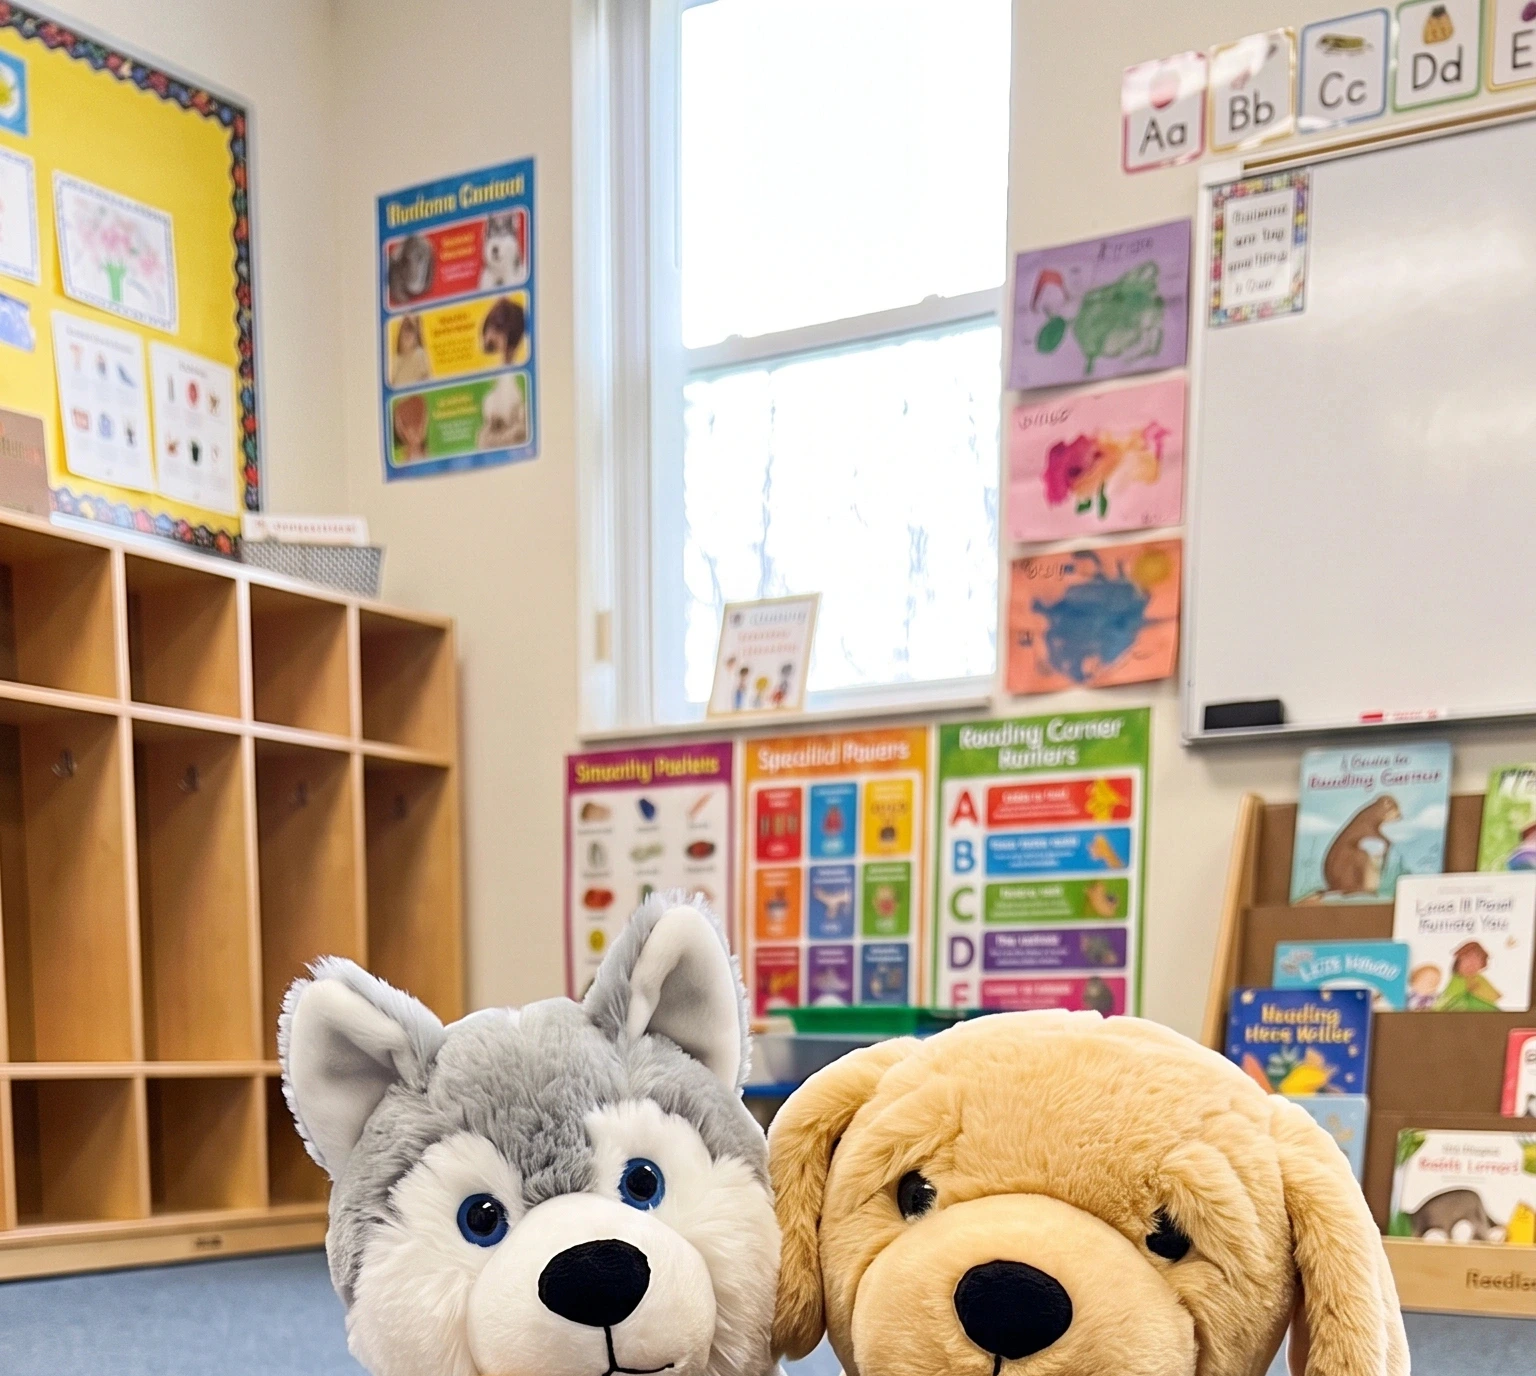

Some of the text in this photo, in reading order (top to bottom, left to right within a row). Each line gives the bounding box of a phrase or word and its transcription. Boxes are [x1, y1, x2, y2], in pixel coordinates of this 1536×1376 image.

[1412, 44, 1463, 91] Dd
[1319, 71, 1366, 109] Cc
[1228, 89, 1275, 132] Bb
[1138, 118, 1187, 156] Aa
[952, 791, 978, 825] A
[954, 840, 974, 873] B
[951, 886, 974, 921] C
[950, 936, 974, 969] D
